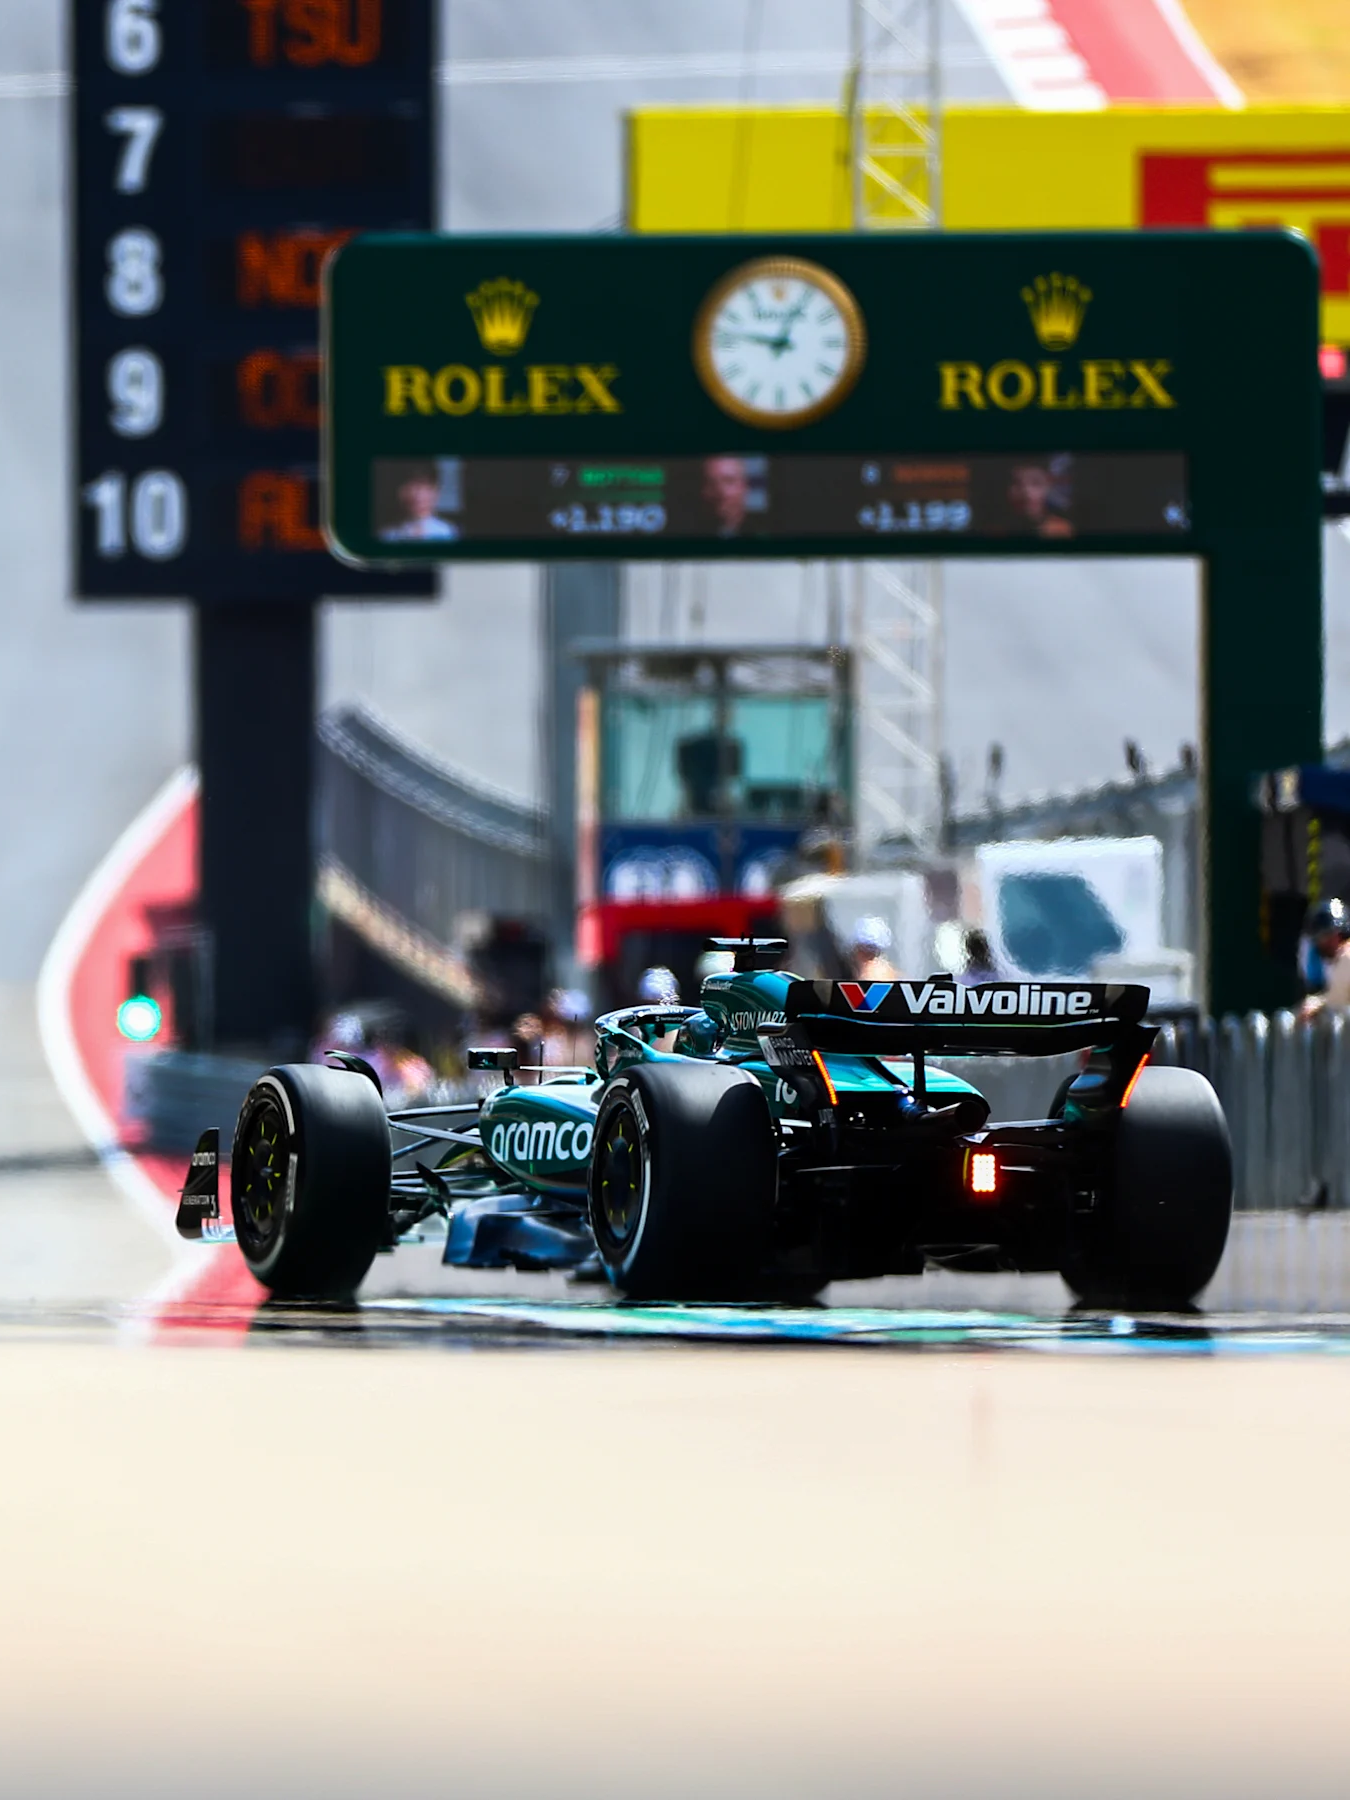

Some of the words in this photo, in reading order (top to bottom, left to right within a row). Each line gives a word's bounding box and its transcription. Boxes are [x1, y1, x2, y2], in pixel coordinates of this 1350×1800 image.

[105, 0, 162, 75] 6
[244, 0, 381, 67] TSU
[106, 105, 163, 194] 7
[106, 227, 163, 319] 8
[108, 346, 163, 438] 9
[384, 363, 622, 416] ROLEX
[937, 359, 1176, 411] ROLEX
[83, 468, 186, 562] 10
[237, 470, 332, 551] AL
[899, 983, 1092, 1015] Valvoline
[491, 1121, 594, 1162] aramco
